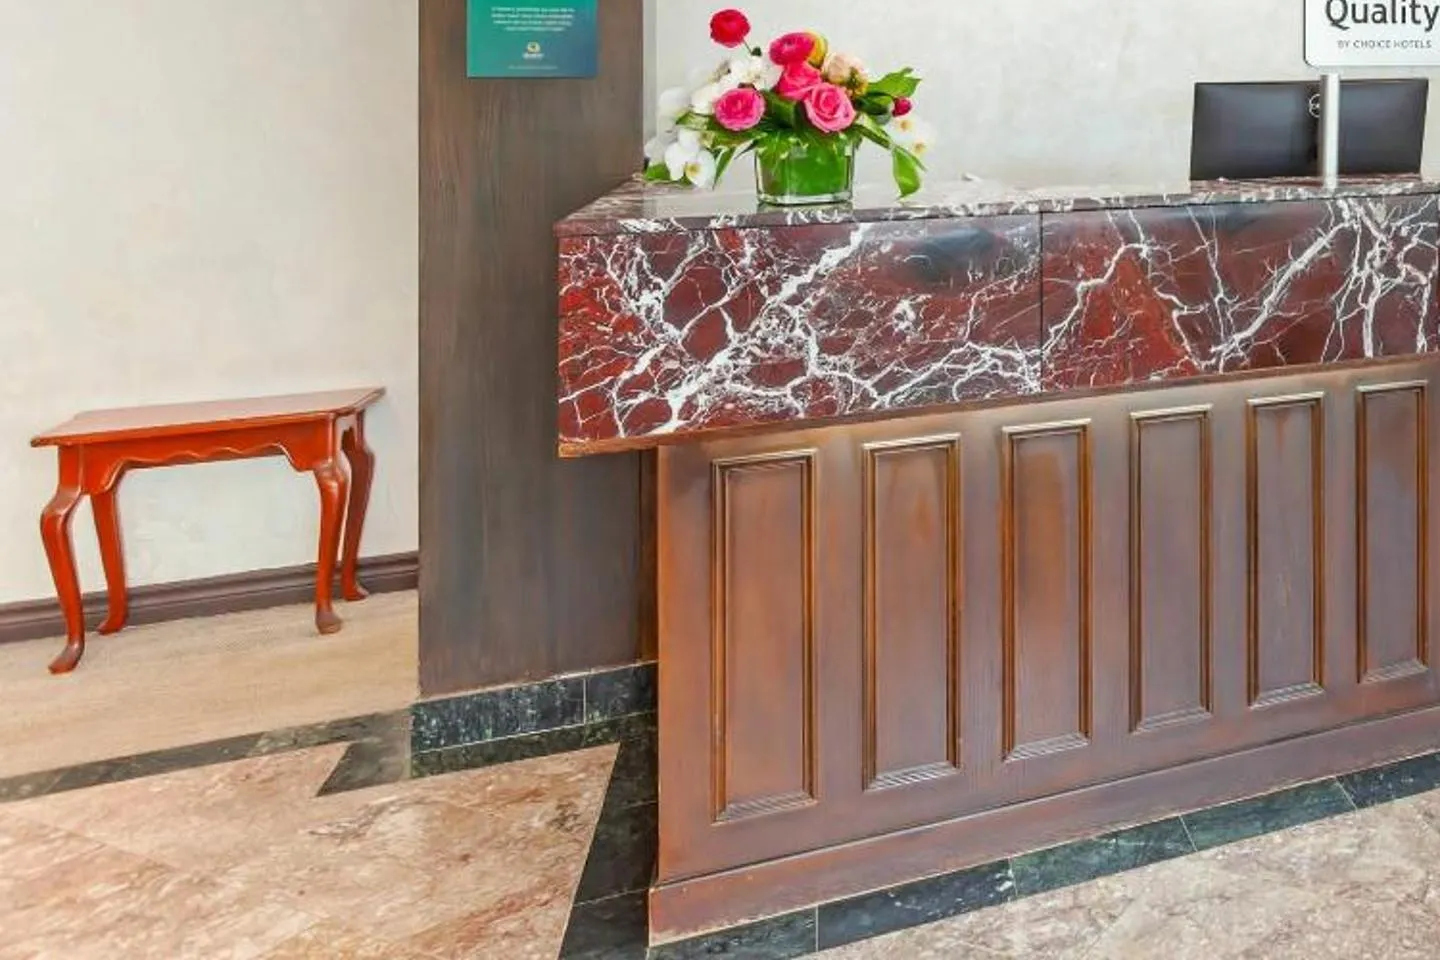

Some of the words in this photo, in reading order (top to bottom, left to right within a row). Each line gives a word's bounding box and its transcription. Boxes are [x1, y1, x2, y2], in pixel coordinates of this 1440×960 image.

[1337, 39, 1350, 49] BY
[1353, 39, 1391, 49] CHOICE
[1393, 39, 1432, 49] HOTELS
